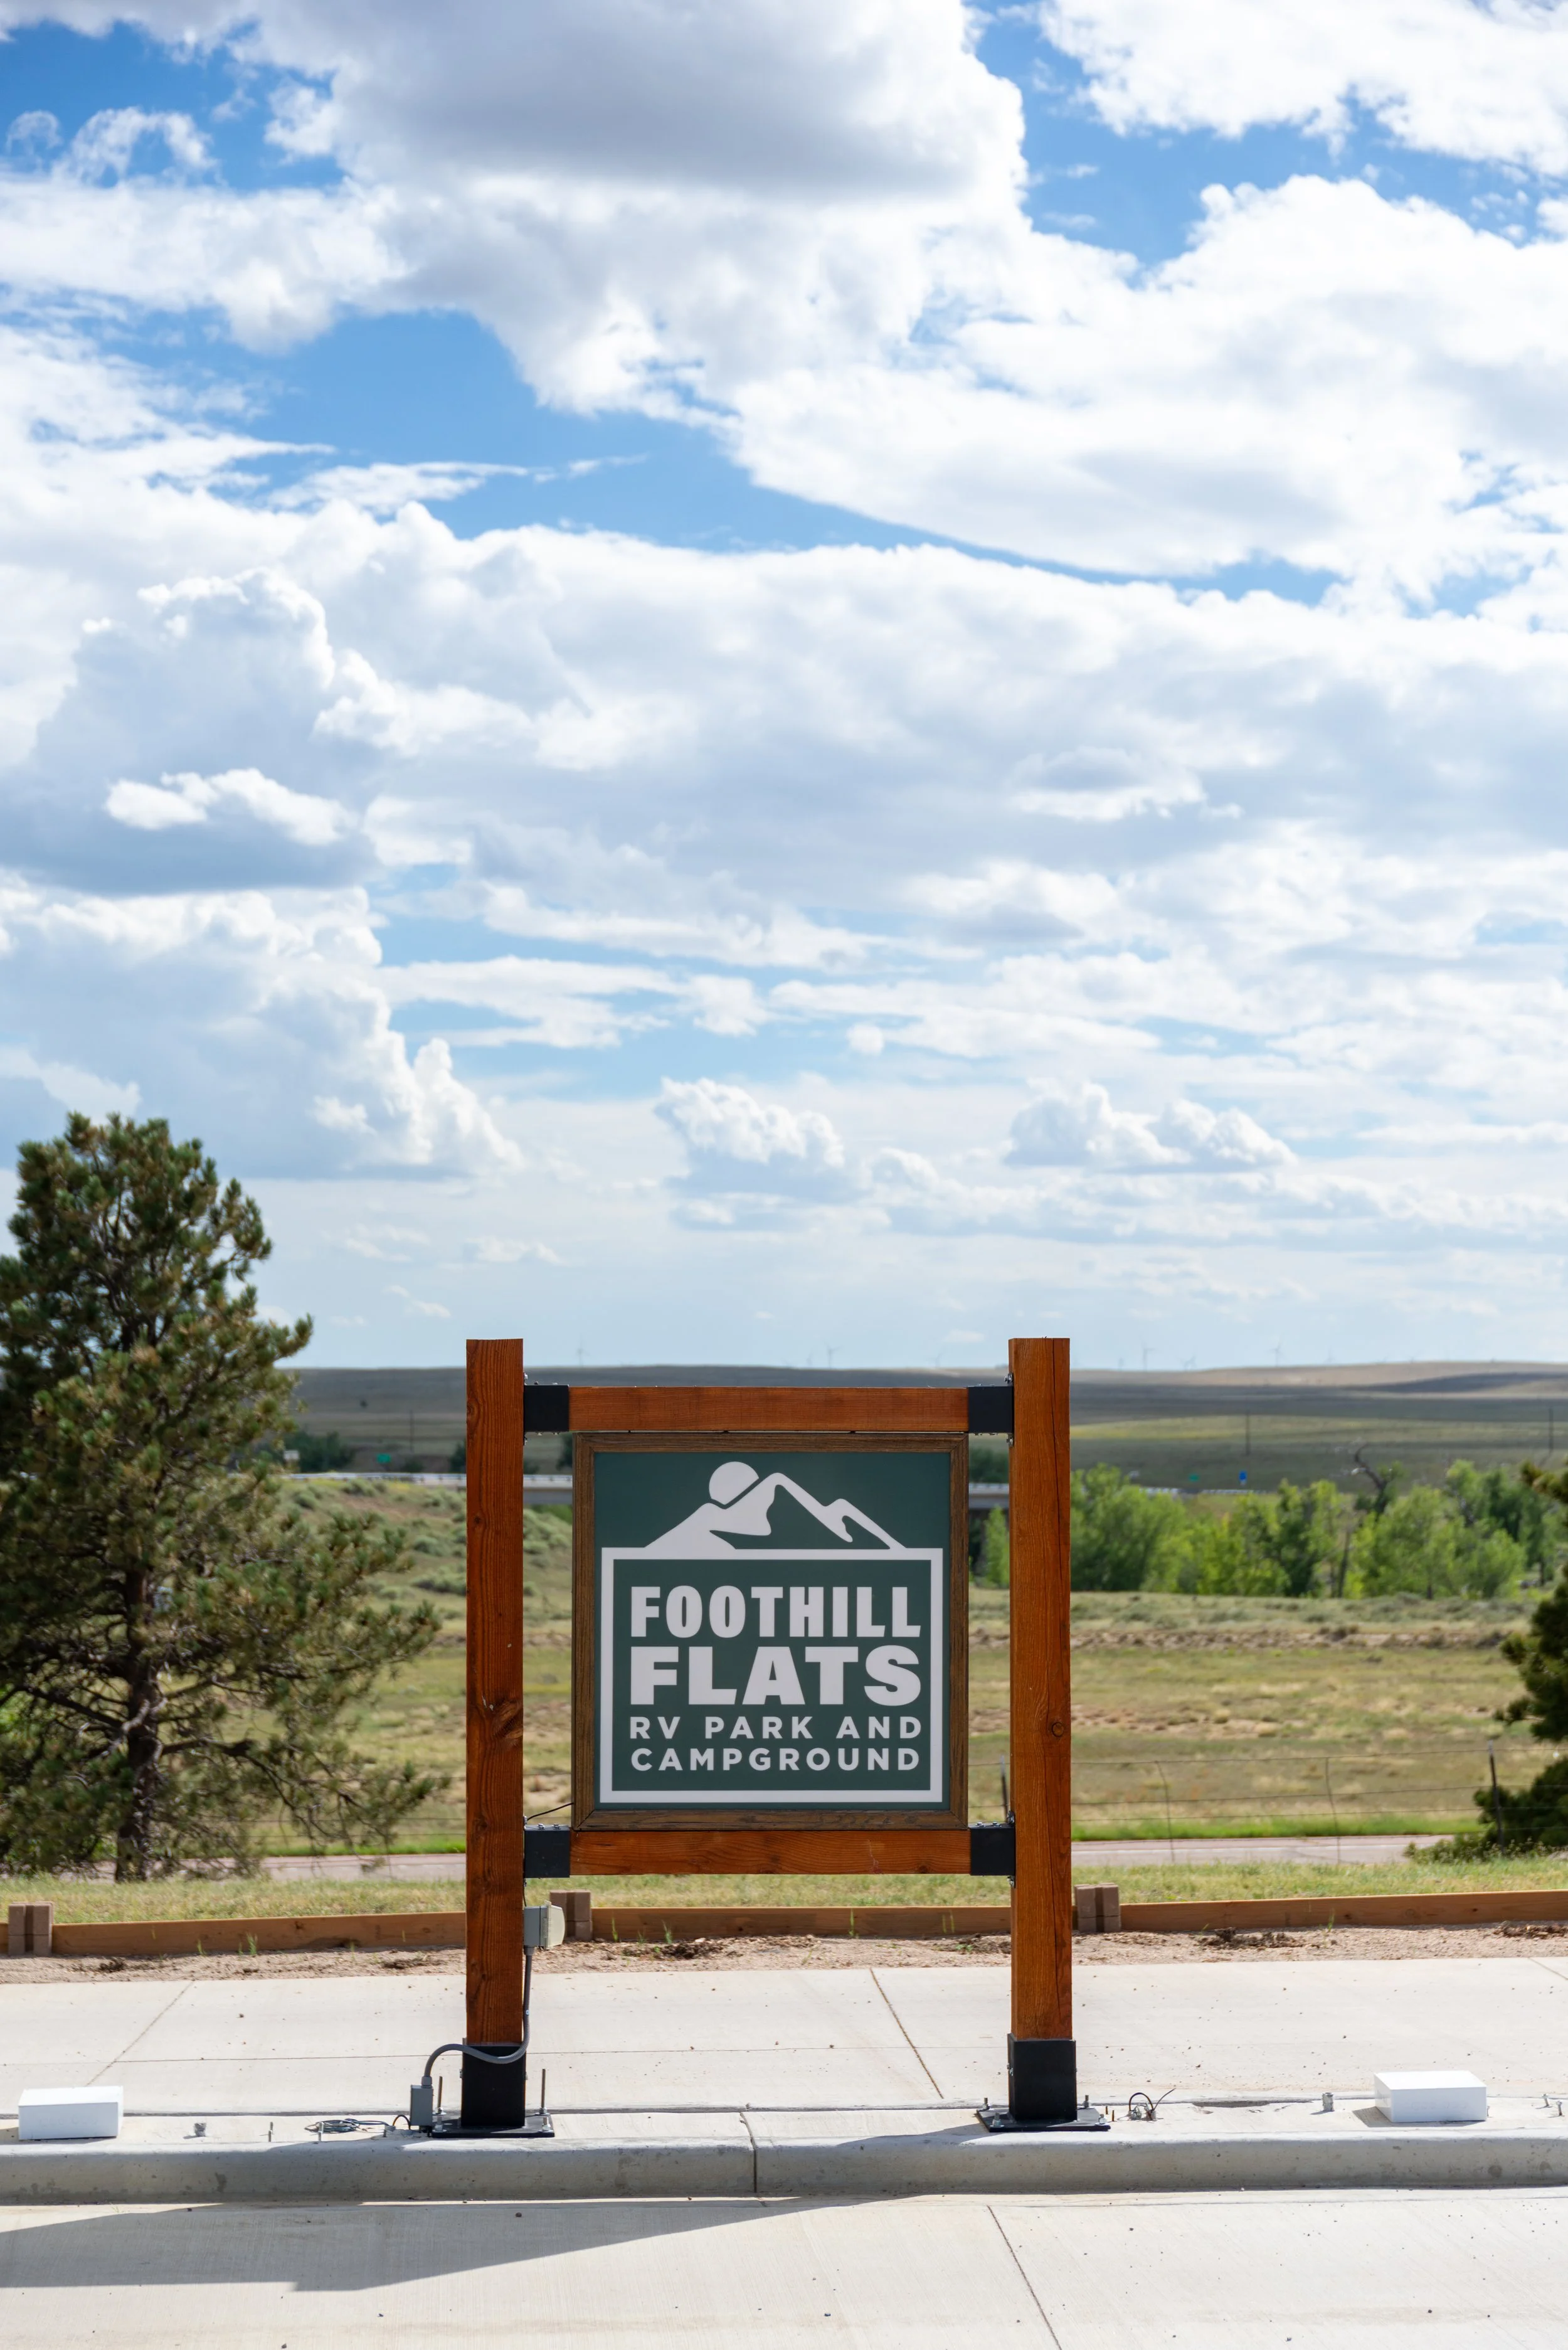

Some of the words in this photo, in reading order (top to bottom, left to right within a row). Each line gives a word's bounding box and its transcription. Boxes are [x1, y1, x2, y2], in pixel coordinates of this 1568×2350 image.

[631, 1586, 921, 1638] FOOTHILL
[630, 1645, 921, 1706] FLATS
[630, 1716, 681, 1739] RV
[705, 1716, 813, 1739] PARK
[836, 1716, 921, 1739] AND
[631, 1747, 919, 1771] CAMPGROUND
